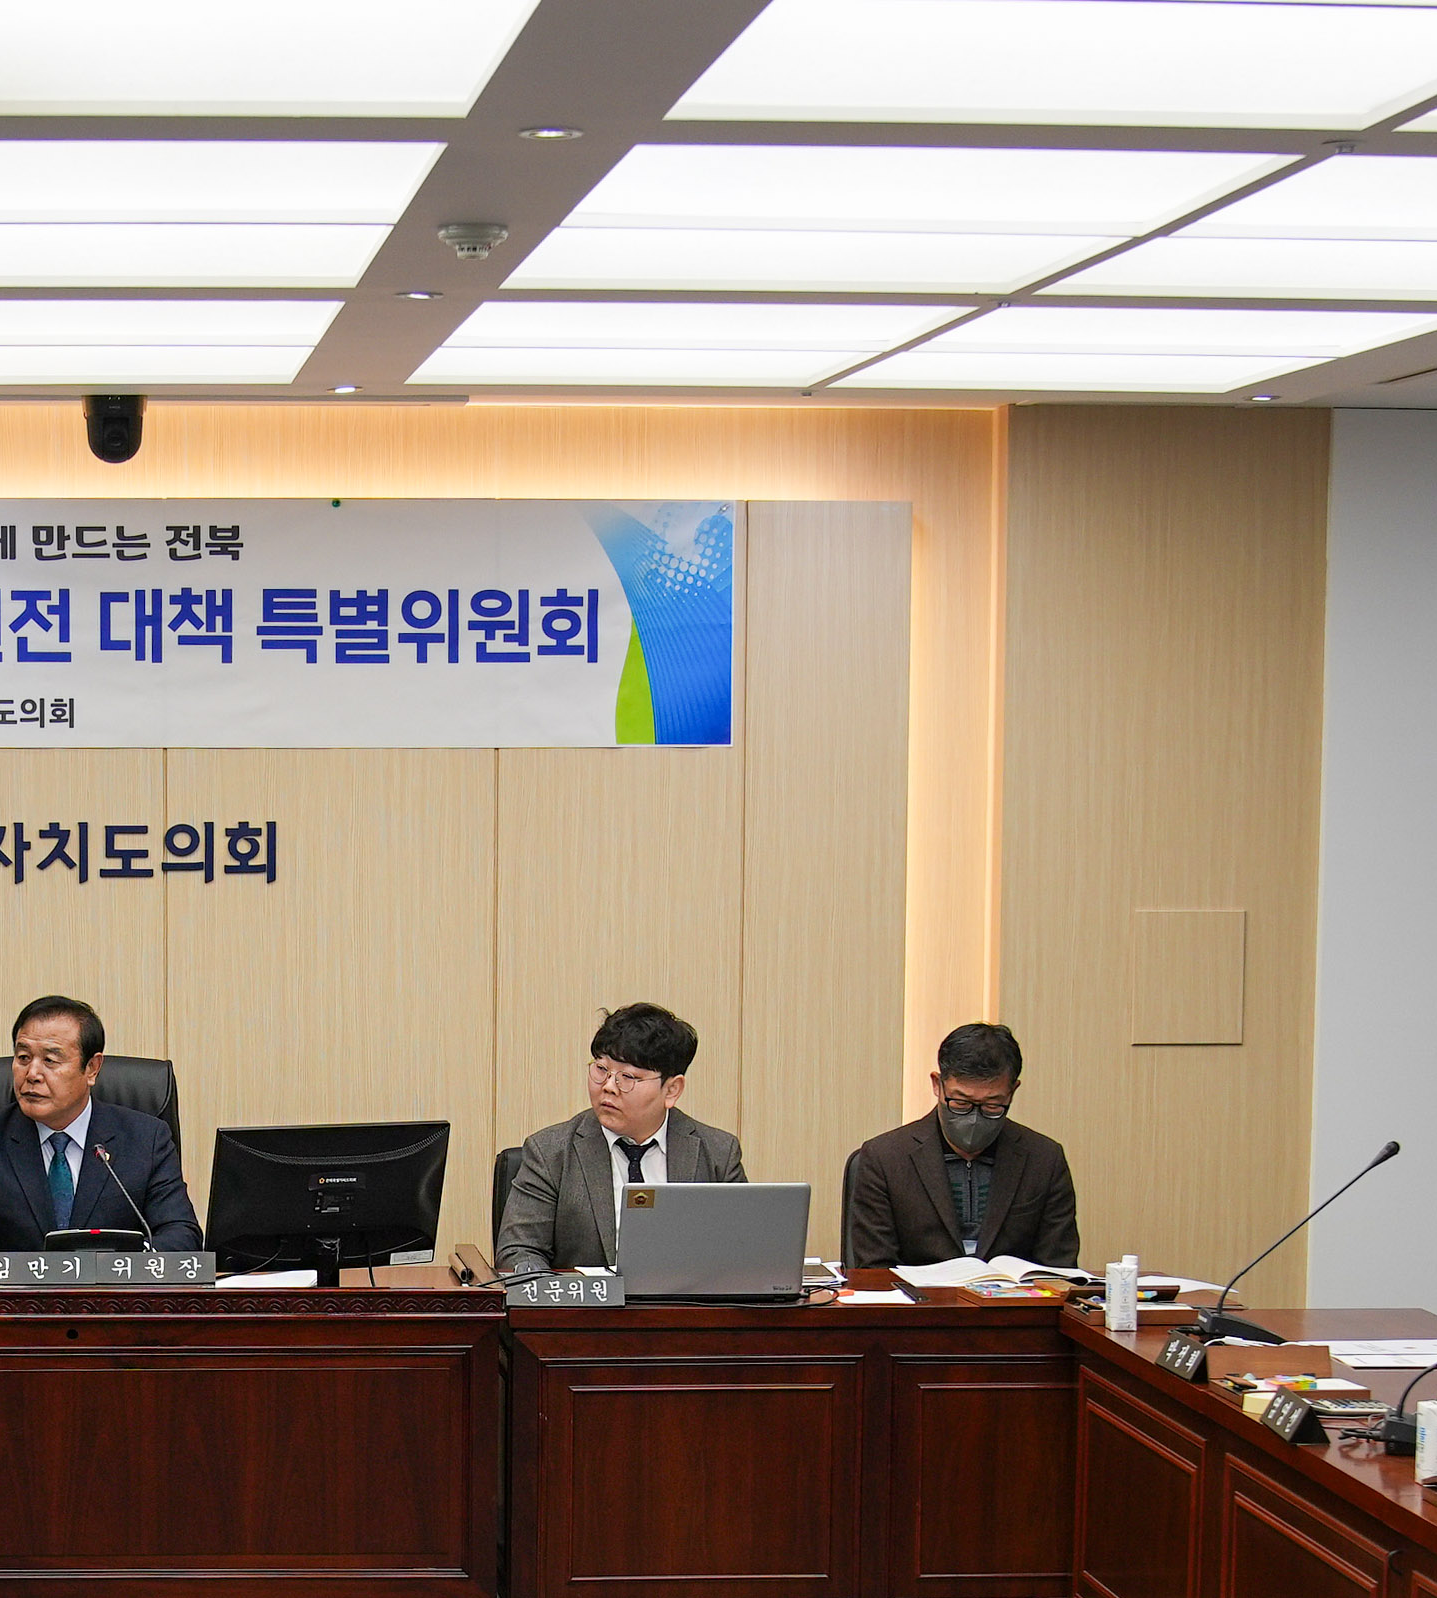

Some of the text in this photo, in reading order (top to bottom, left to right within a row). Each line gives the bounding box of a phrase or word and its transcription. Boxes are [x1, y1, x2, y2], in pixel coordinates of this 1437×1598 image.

[32, 526, 150, 561] 만드는
[166, 525, 243, 561] 전북
[100, 588, 232, 663] 대책
[257, 589, 598, 663] 특별위원회
[111, 1257, 202, 1279] 위원장
[521, 1280, 607, 1302] 전문위원
